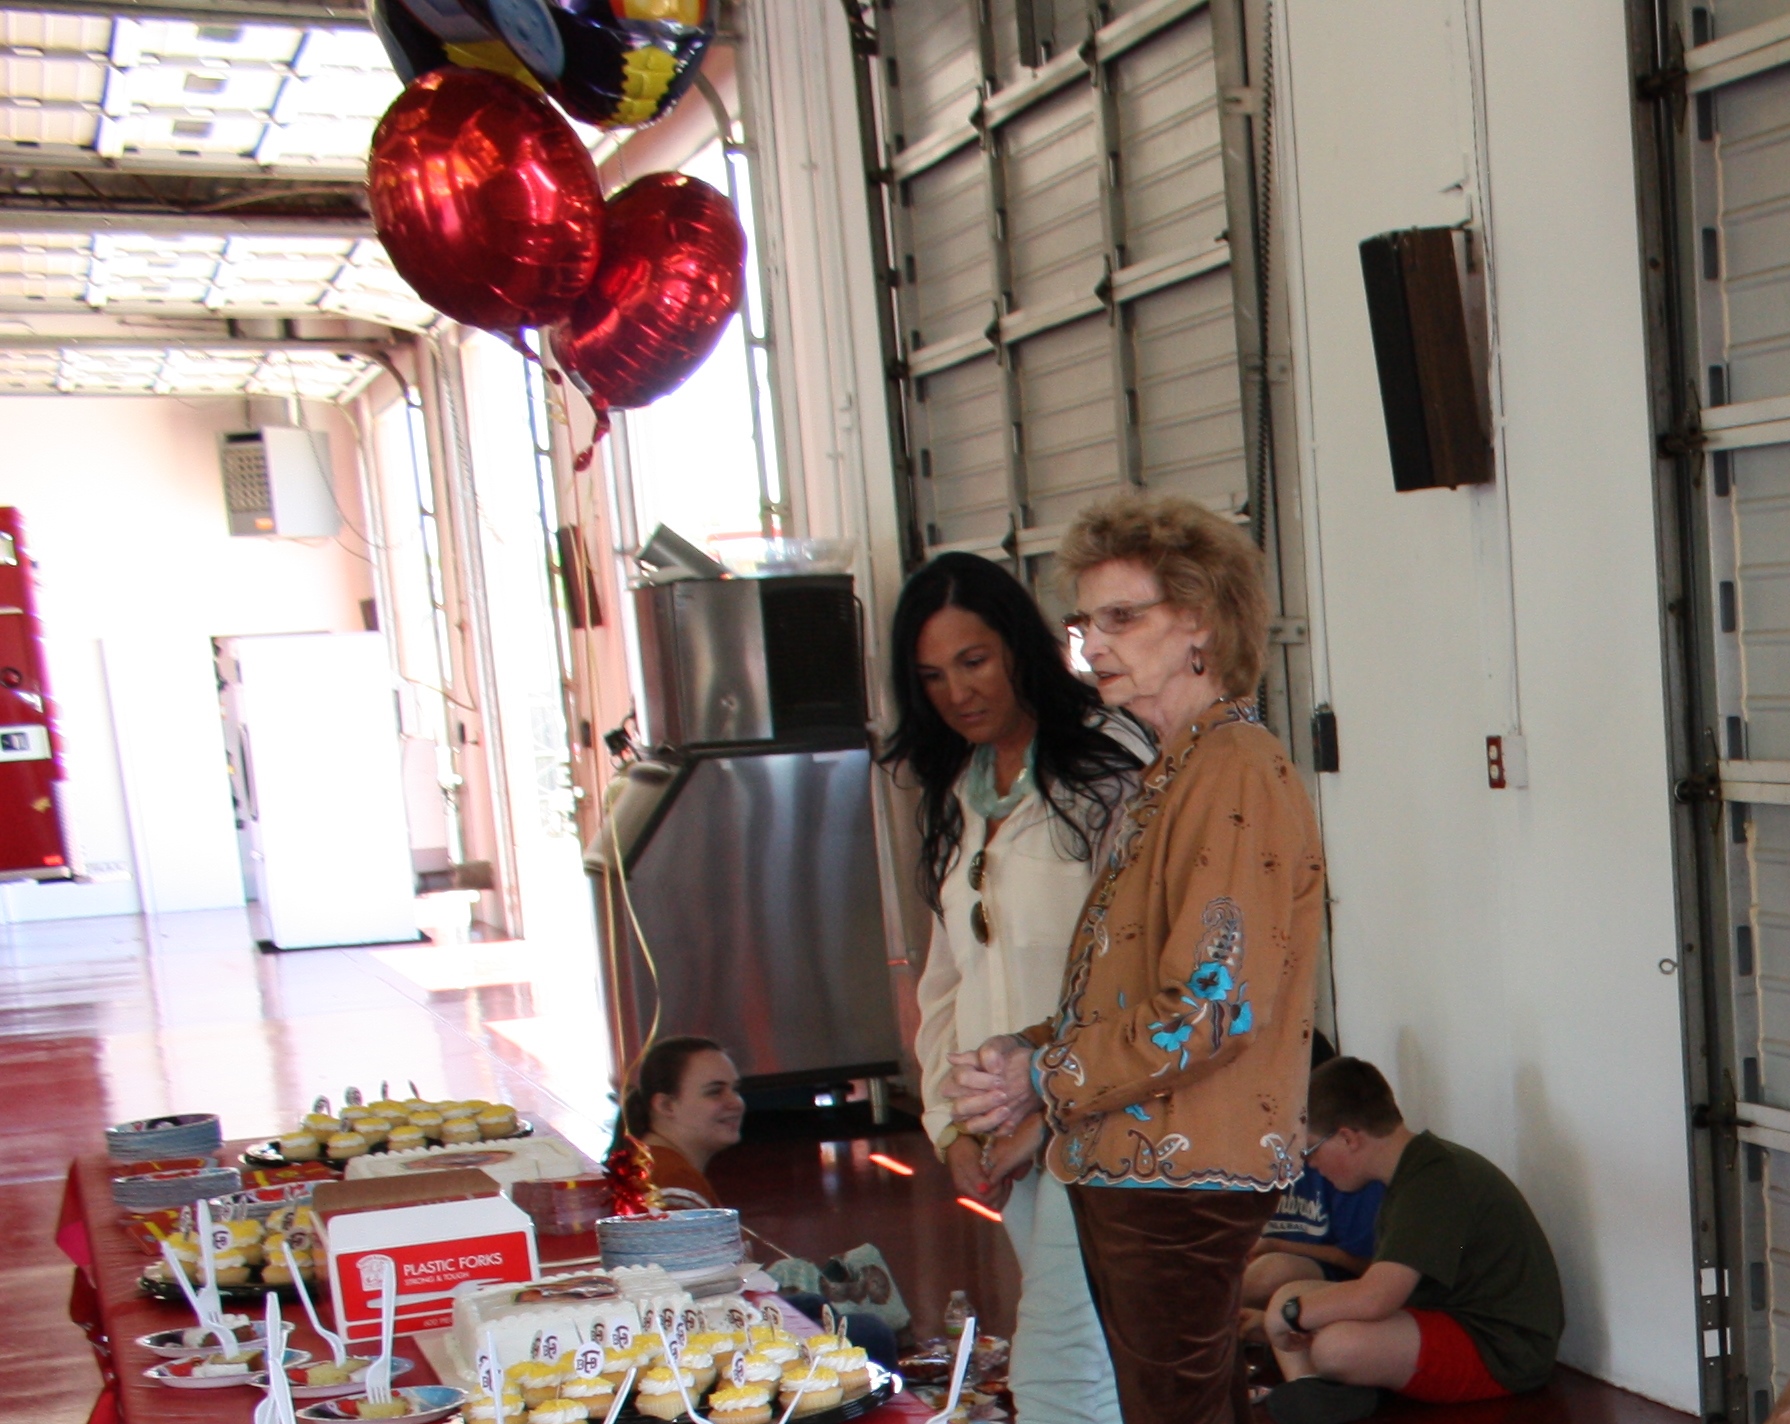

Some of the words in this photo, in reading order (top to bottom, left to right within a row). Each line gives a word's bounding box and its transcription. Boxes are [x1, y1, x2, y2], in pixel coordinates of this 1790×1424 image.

[403, 1258, 456, 1277] PLASTIC
[459, 1252, 504, 1269] FORKS
[404, 1276, 435, 1286] STRONG
[444, 1271, 470, 1281] TOUGH
